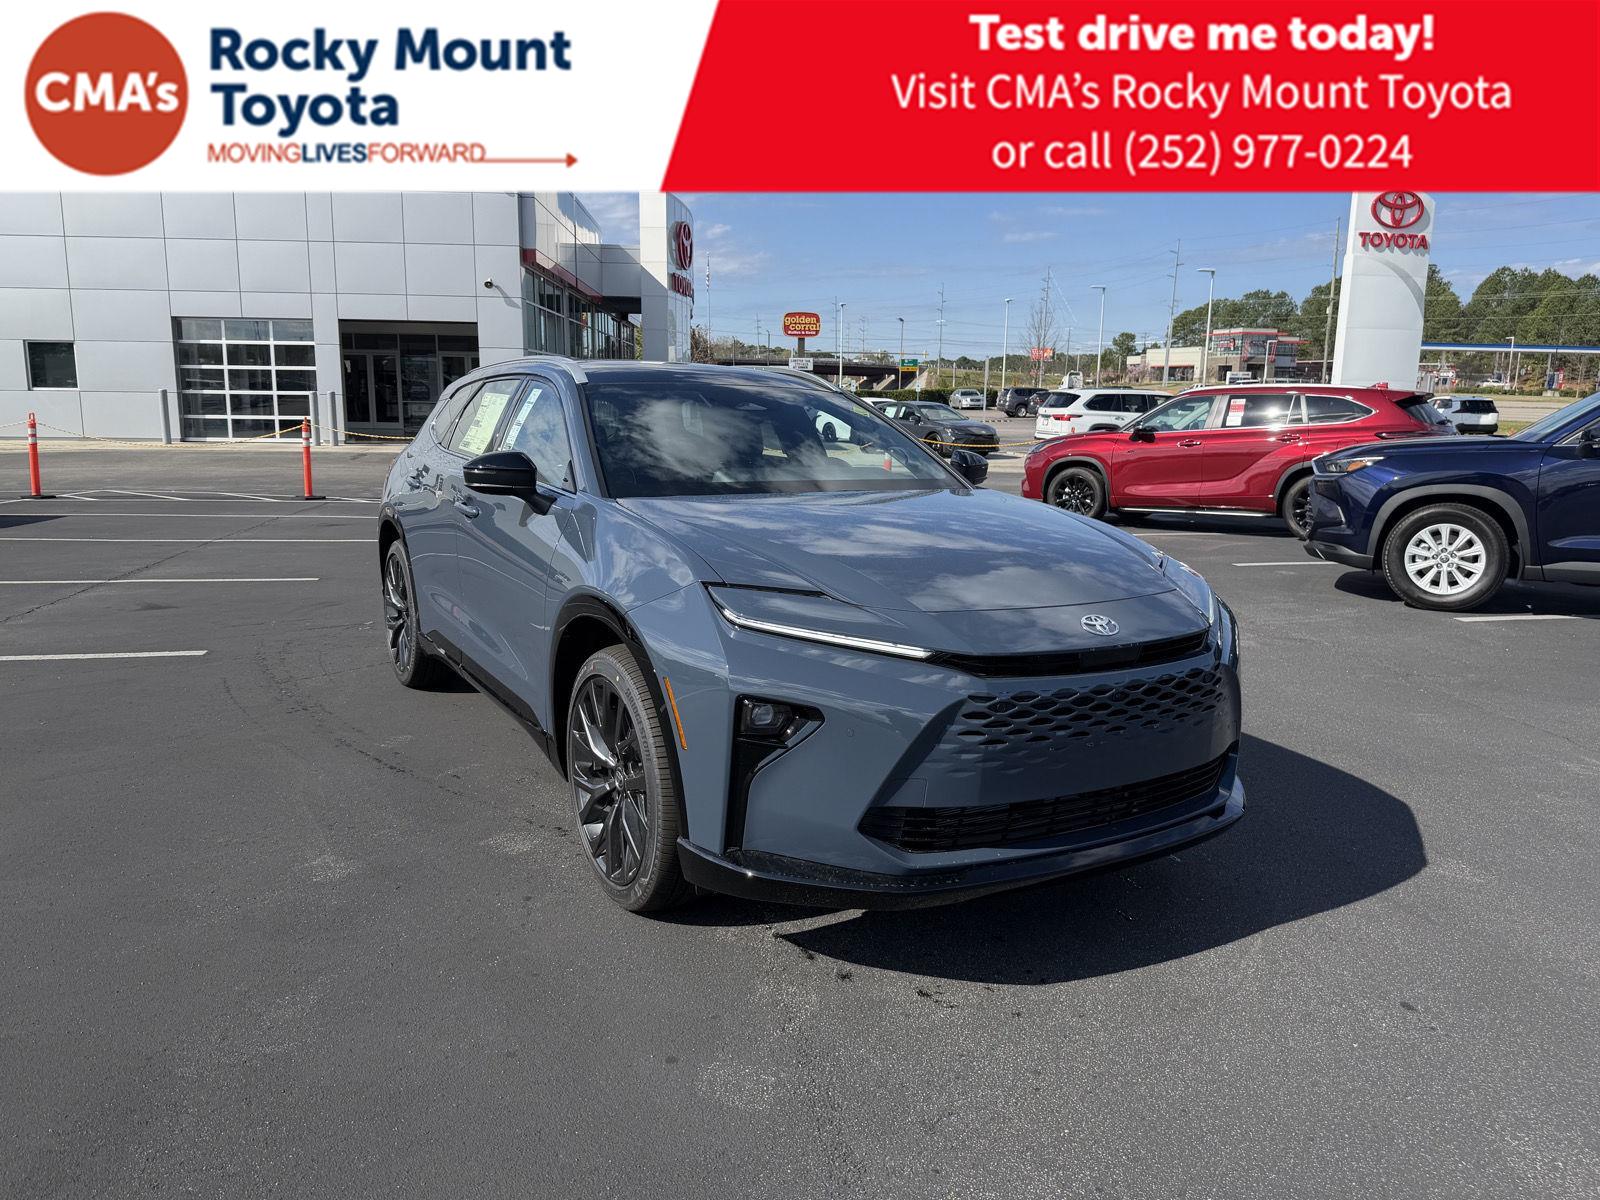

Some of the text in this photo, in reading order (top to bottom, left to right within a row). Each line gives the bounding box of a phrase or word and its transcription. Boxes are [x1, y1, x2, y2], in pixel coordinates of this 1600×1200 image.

[1359, 232, 1428, 250] TOYOTA
[671, 272, 694, 302] TOYO
[784, 316, 817, 325] golden
[790, 323, 820, 331] corral
